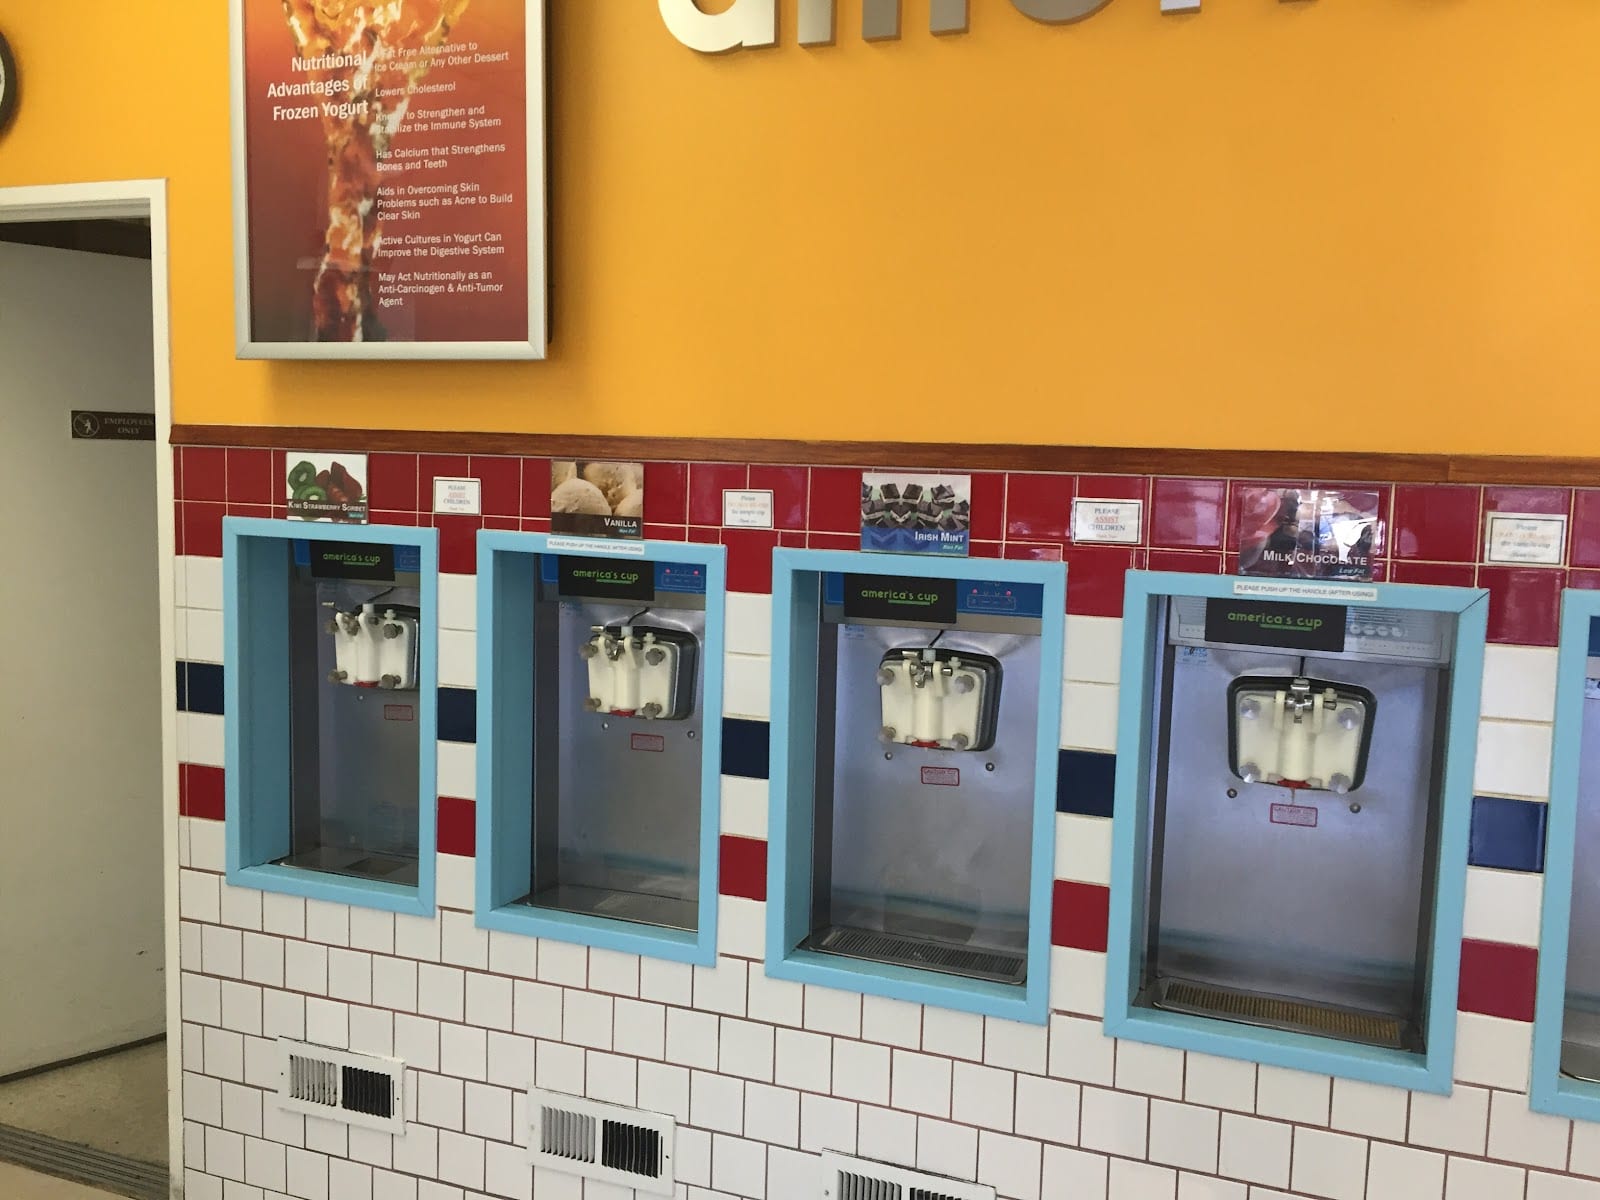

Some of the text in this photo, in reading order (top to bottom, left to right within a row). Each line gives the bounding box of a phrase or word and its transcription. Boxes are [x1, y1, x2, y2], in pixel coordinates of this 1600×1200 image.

[398, 47, 417, 58] Free
[420, 43, 466, 56] Alternative
[468, 42, 478, 51] to
[291, 50, 367, 72] Nutritional
[374, 51, 509, 73] Ice Cream or Any Other Dessert
[267, 74, 368, 98] Advantages of
[375, 81, 456, 97] Lowers Cholesterol
[273, 100, 369, 120] Frozen Yogurt
[406, 111, 415, 120] to
[417, 107, 466, 120] Strengthen
[468, 105, 485, 115] and
[414, 122, 429, 131] the
[430, 120, 467, 131] Immune
[468, 118, 502, 130] System
[376, 143, 506, 159] Has Calcium that Strengthens
[376, 158, 448, 172] Bones and Teeth
[376, 182, 480, 196] Aids in Overcoming Skin
[377, 193, 513, 209] Problems such as Acne to Build
[377, 210, 420, 221] Clear Skin
[378, 232, 502, 246] Active Cultures in Yogurt Can
[377, 245, 505, 259] Improve the Digestive System
[378, 270, 493, 284] May Act Nutritionally as an
[378, 282, 504, 295] Anti-Carcinogen & Anti-Tumor
[378, 297, 404, 308] Agent
[604, 517, 638, 528] VANILLA
[915, 531, 964, 542] IRISH MINT
[322, 551, 381, 564] america's cup
[1263, 550, 1367, 566] MILK CHOCOLATE
[572, 569, 639, 583] america's cup
[861, 588, 938, 604] america's cup
[1227, 611, 1323, 630] america's cup
